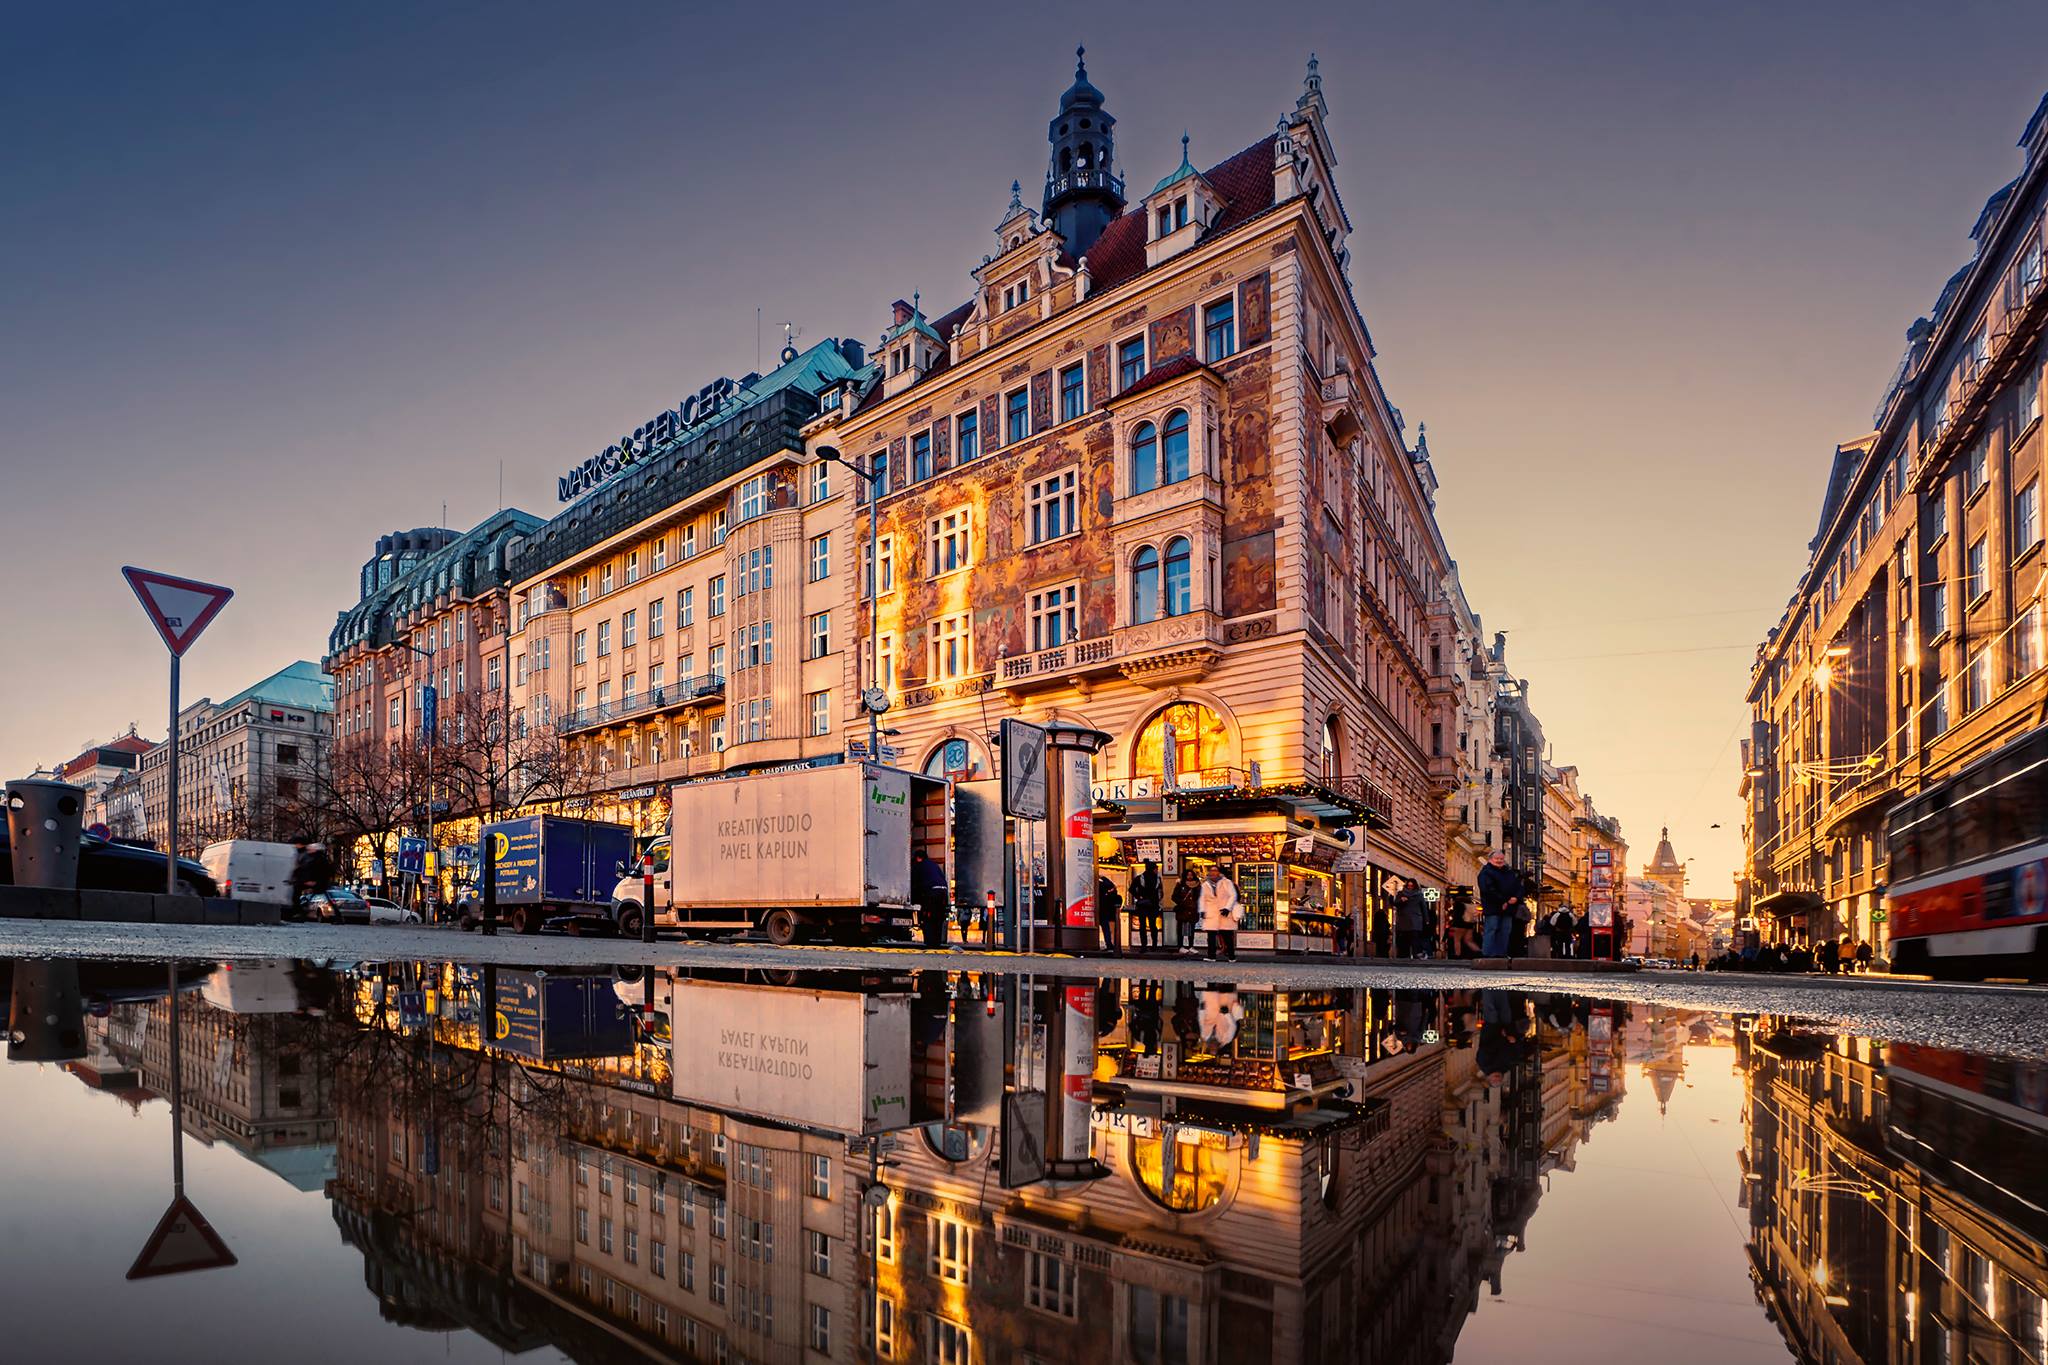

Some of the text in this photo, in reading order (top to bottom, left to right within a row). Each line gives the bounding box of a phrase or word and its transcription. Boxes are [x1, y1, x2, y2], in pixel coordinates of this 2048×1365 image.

[1092, 783, 1149, 801] OKS
[718, 813, 812, 837] KREATIVSTUDIO
[720, 840, 808, 860] PAVEL KAPLUN
